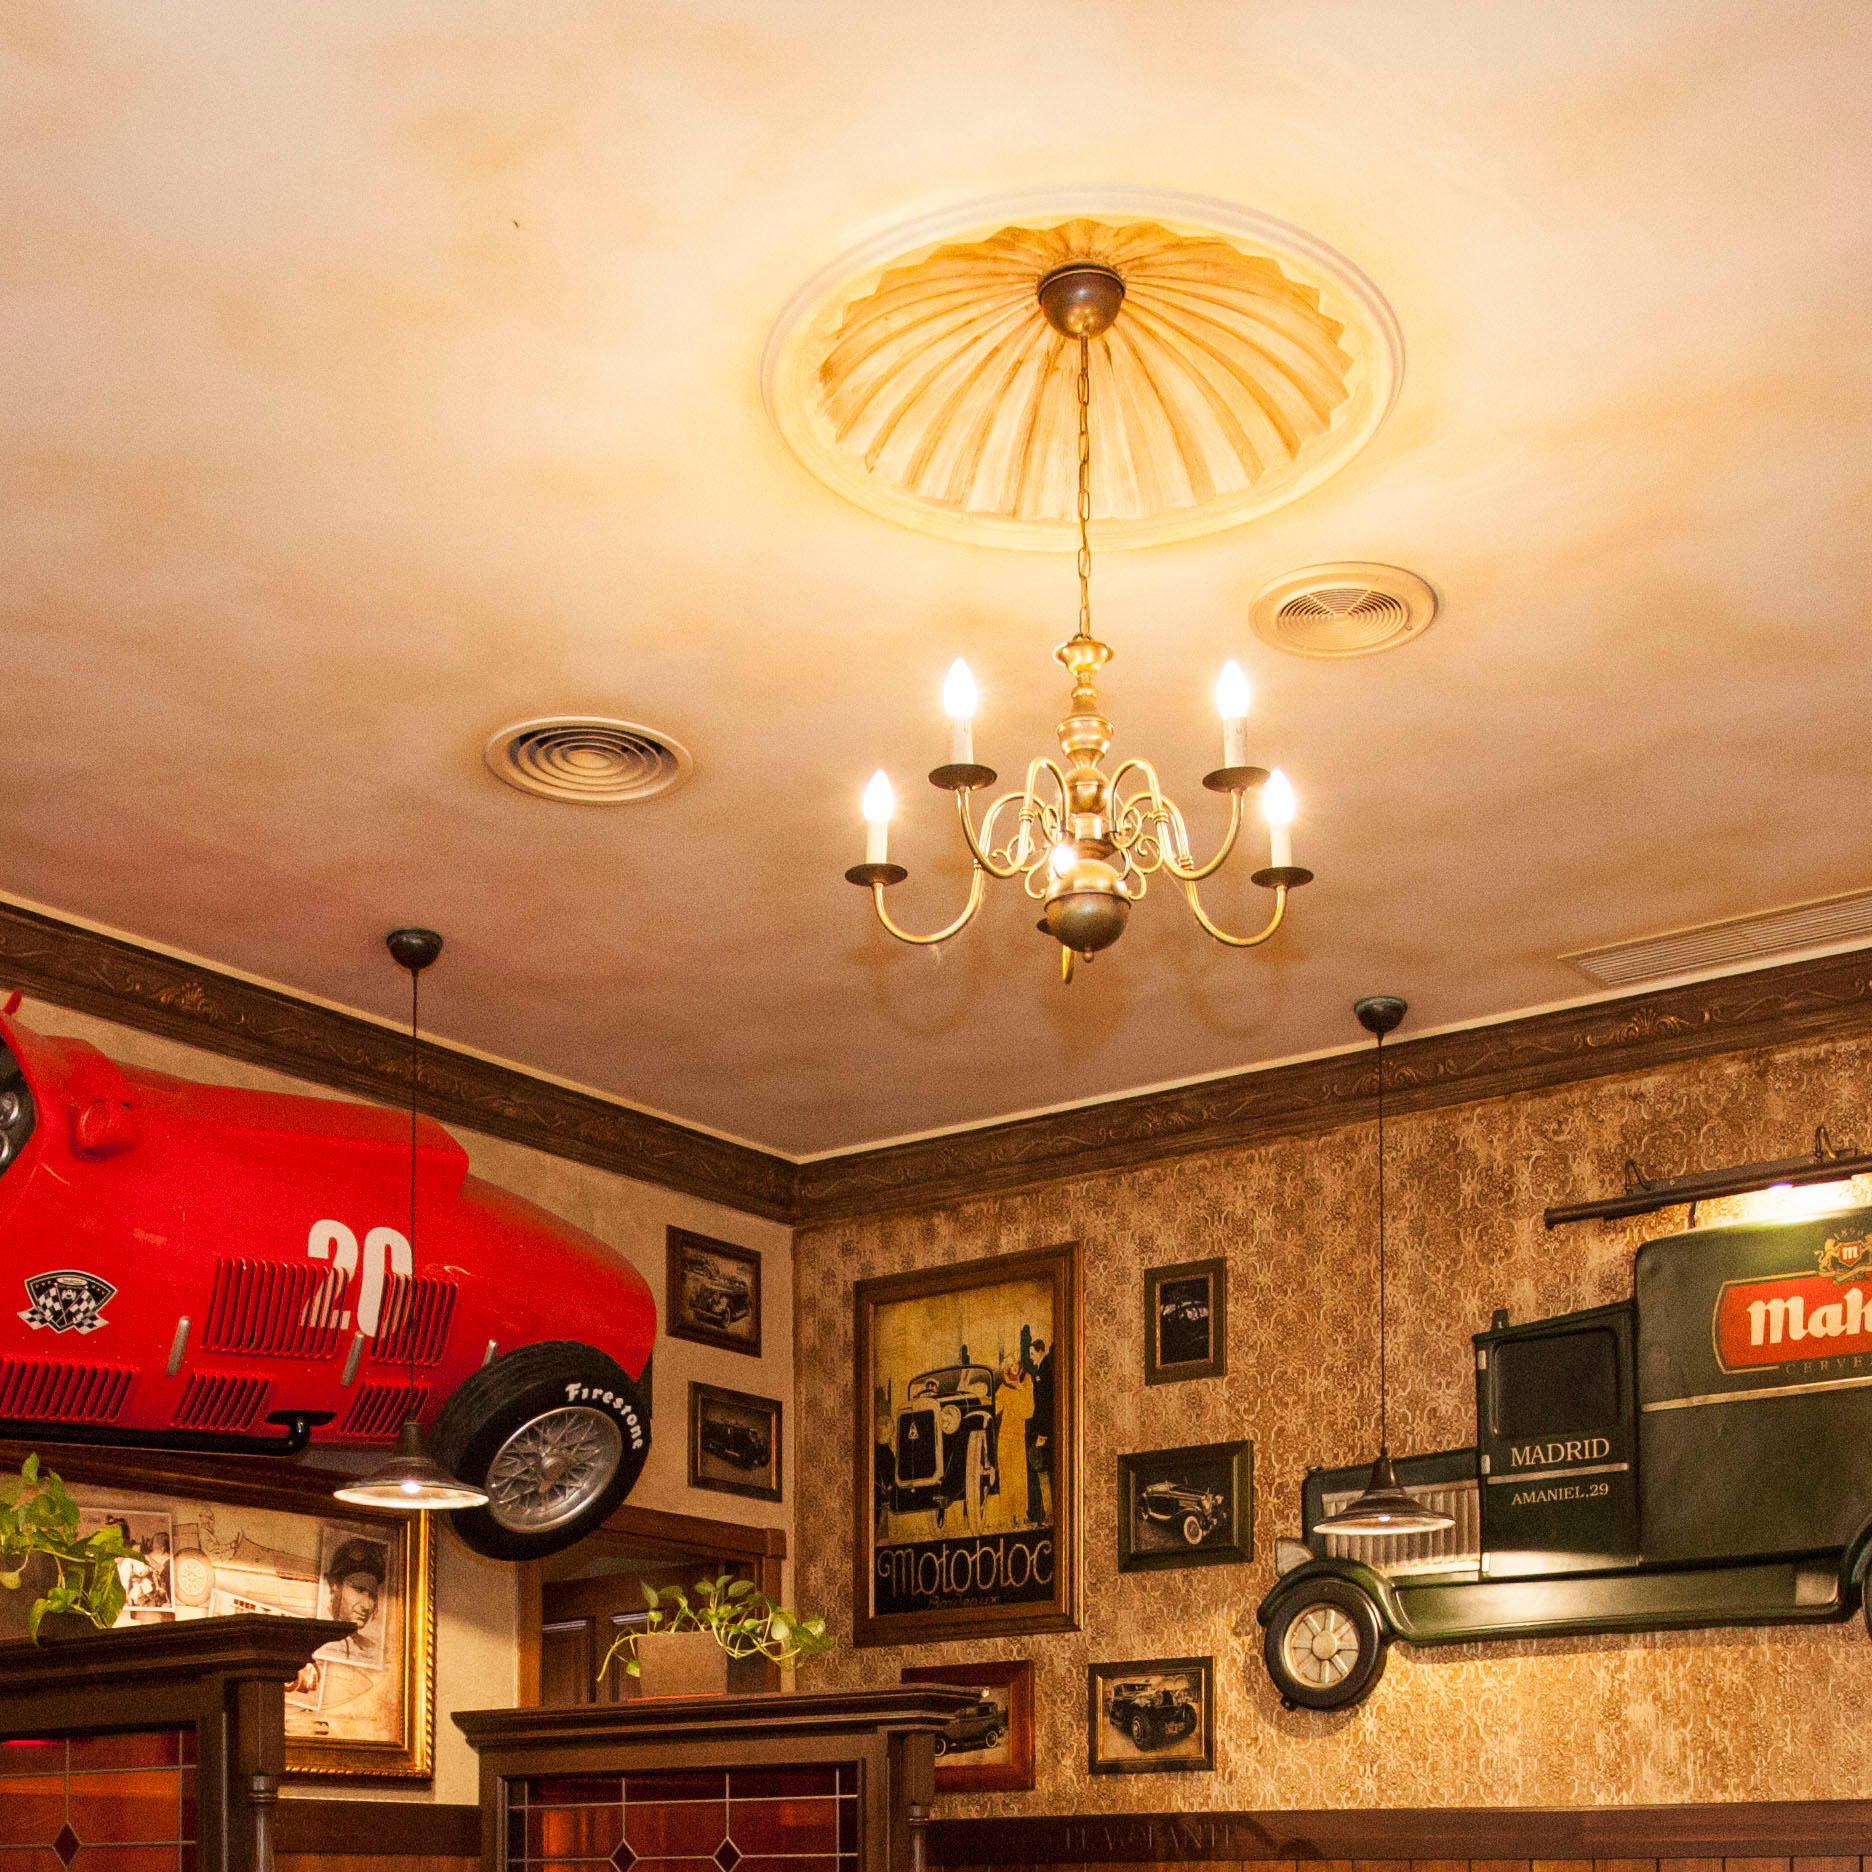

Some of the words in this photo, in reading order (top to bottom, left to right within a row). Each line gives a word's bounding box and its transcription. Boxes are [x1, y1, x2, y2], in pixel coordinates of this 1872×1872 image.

[300, 1219, 415, 1339] 20
[565, 1382, 644, 1450] Firestone
[1510, 1437, 1611, 1468] MADRID
